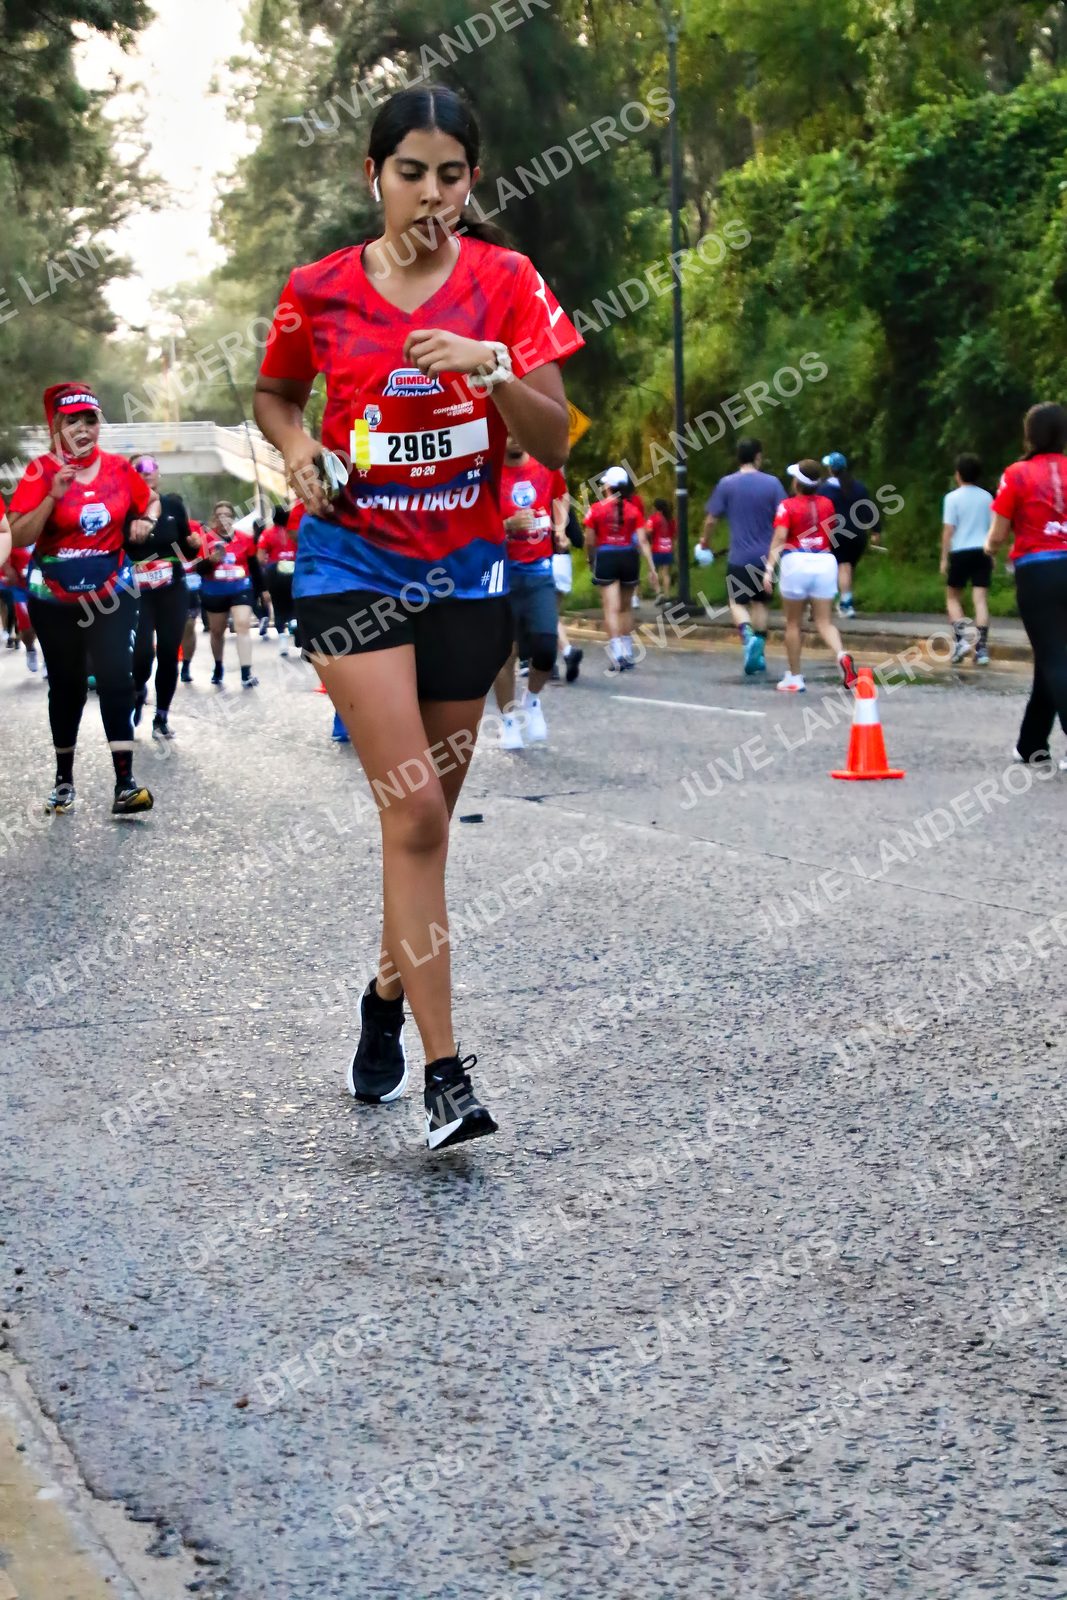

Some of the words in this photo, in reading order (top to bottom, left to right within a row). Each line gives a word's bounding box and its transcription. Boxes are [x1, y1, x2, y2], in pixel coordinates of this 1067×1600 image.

[395, 375, 432, 385] BIMBO
[388, 430, 452, 463] 2965
[467, 468, 481, 480] 5K
